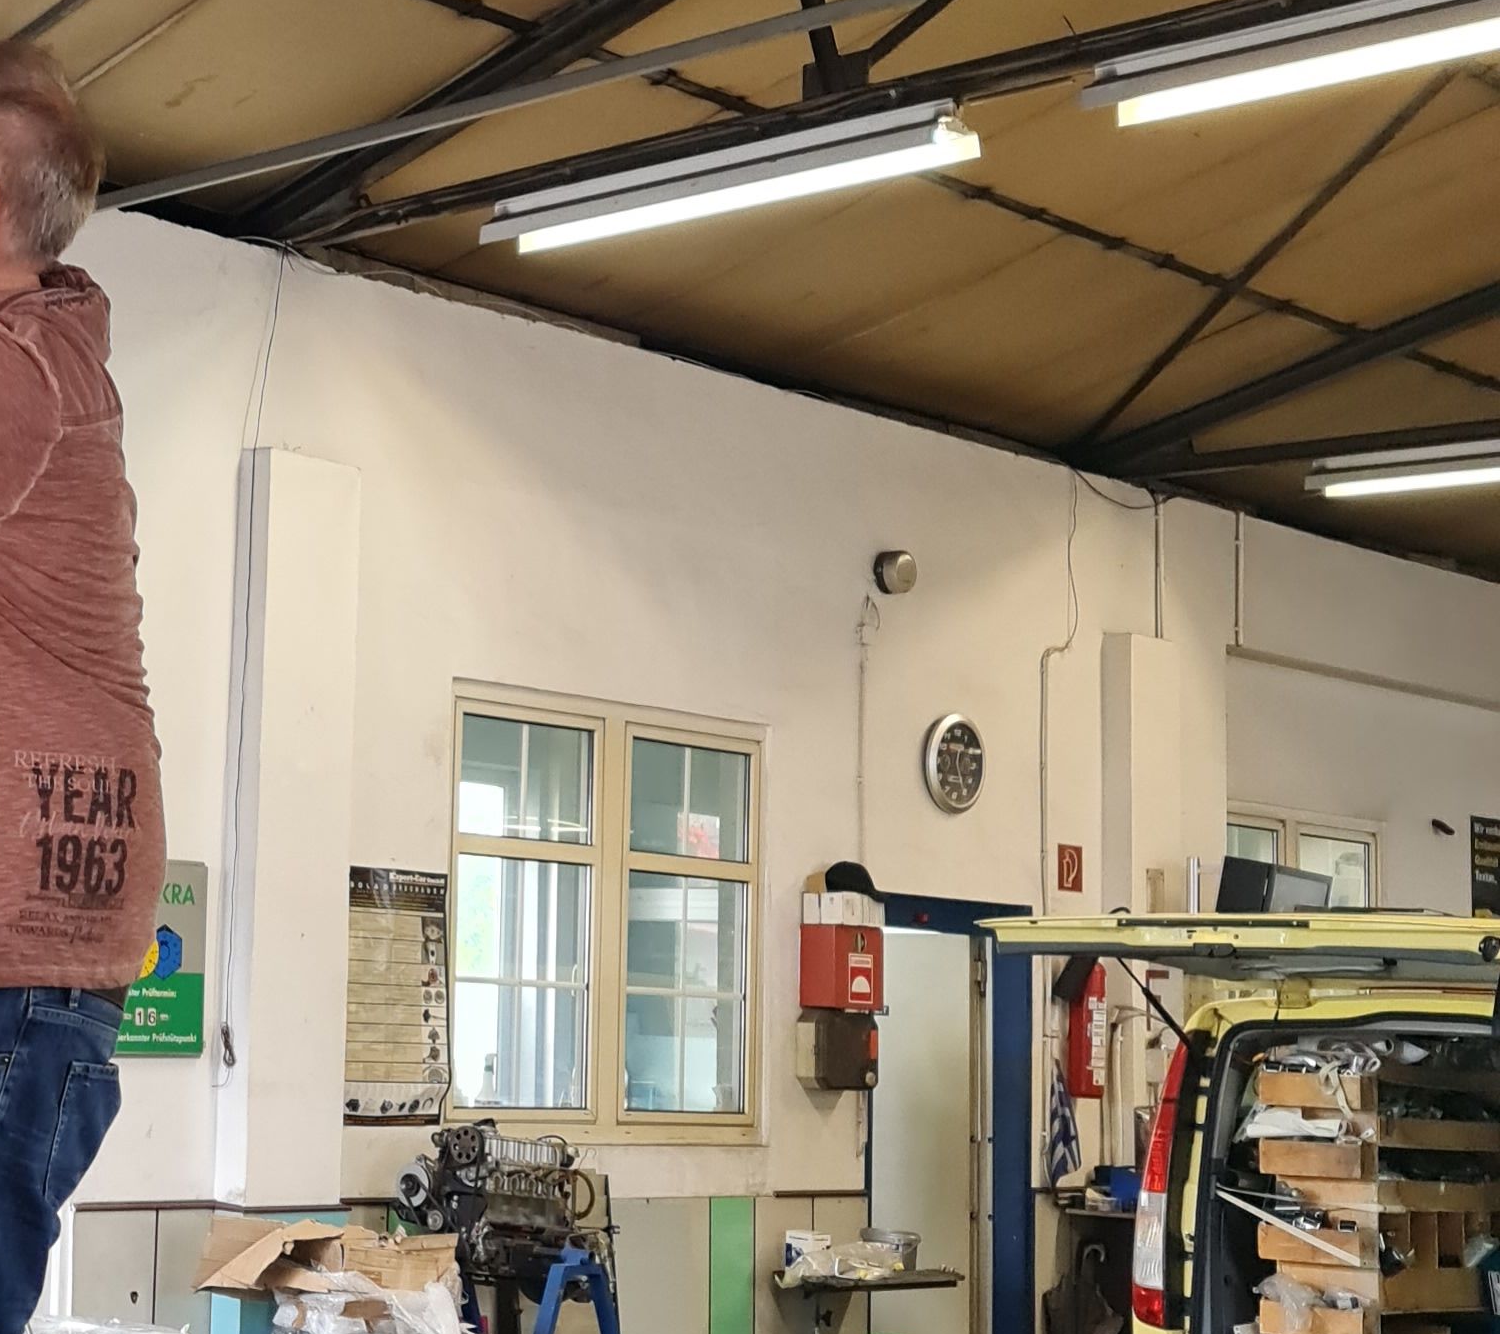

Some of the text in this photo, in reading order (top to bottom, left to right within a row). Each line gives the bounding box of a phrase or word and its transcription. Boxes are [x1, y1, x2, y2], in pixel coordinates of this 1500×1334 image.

[13, 750, 116, 773] REFRESH
[32, 761, 138, 829] YEAR
[35, 833, 129, 896] 1963
